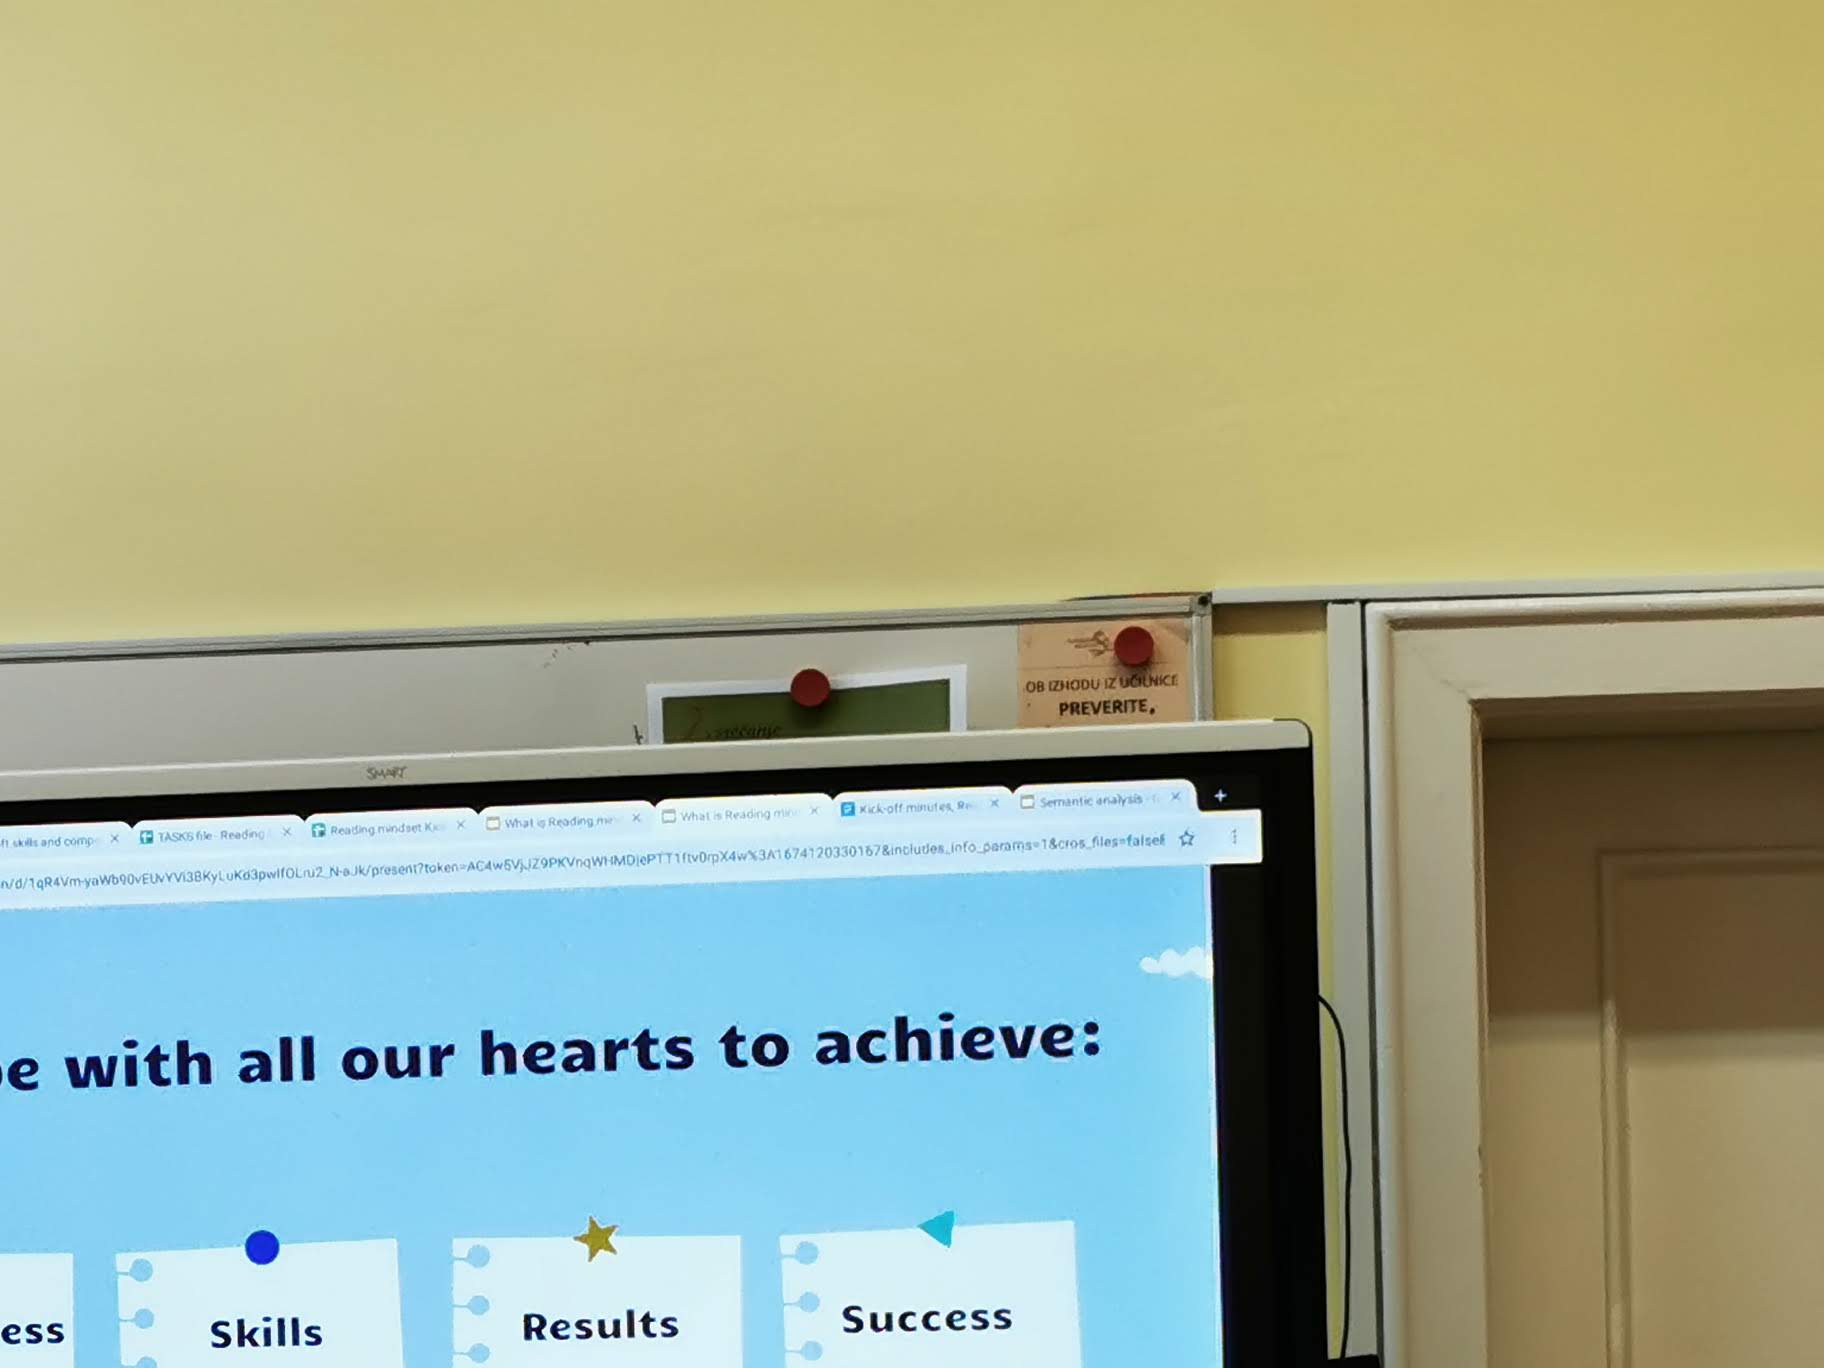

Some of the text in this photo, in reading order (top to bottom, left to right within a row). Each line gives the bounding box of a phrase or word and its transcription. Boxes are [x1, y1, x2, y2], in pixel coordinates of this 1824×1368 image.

[1026, 681, 1044, 693] OB
[1049, 679, 1100, 691] IZHODU
[1105, 678, 1116, 689] IZ
[367, 767, 407, 779] SMART
[1040, 793, 1143, 808] Semantic analysis
[681, 811, 710, 821] What
[714, 811, 722, 820] is
[725, 808, 771, 820] Reading
[860, 803, 903, 814] Kick-off
[505, 818, 533, 828] What
[549, 816, 594, 828] Reading
[196, 830, 212, 840] file
[221, 829, 264, 840] Reading
[331, 825, 375, 836] Reading
[378, 823, 421, 834] mindset
[13, 838, 38, 848] skills
[41, 837, 61, 848] and
[63, 1039, 213, 1089] with
[237, 1035, 316, 1084] all
[341, 1043, 456, 1081] our
[480, 1028, 695, 1077] hearts
[718, 1025, 790, 1069] to
[815, 1011, 1100, 1066] achieve:
[523, 1308, 679, 1342] Results
[842, 1305, 1013, 1334] Success
[210, 1316, 323, 1349] Skills
